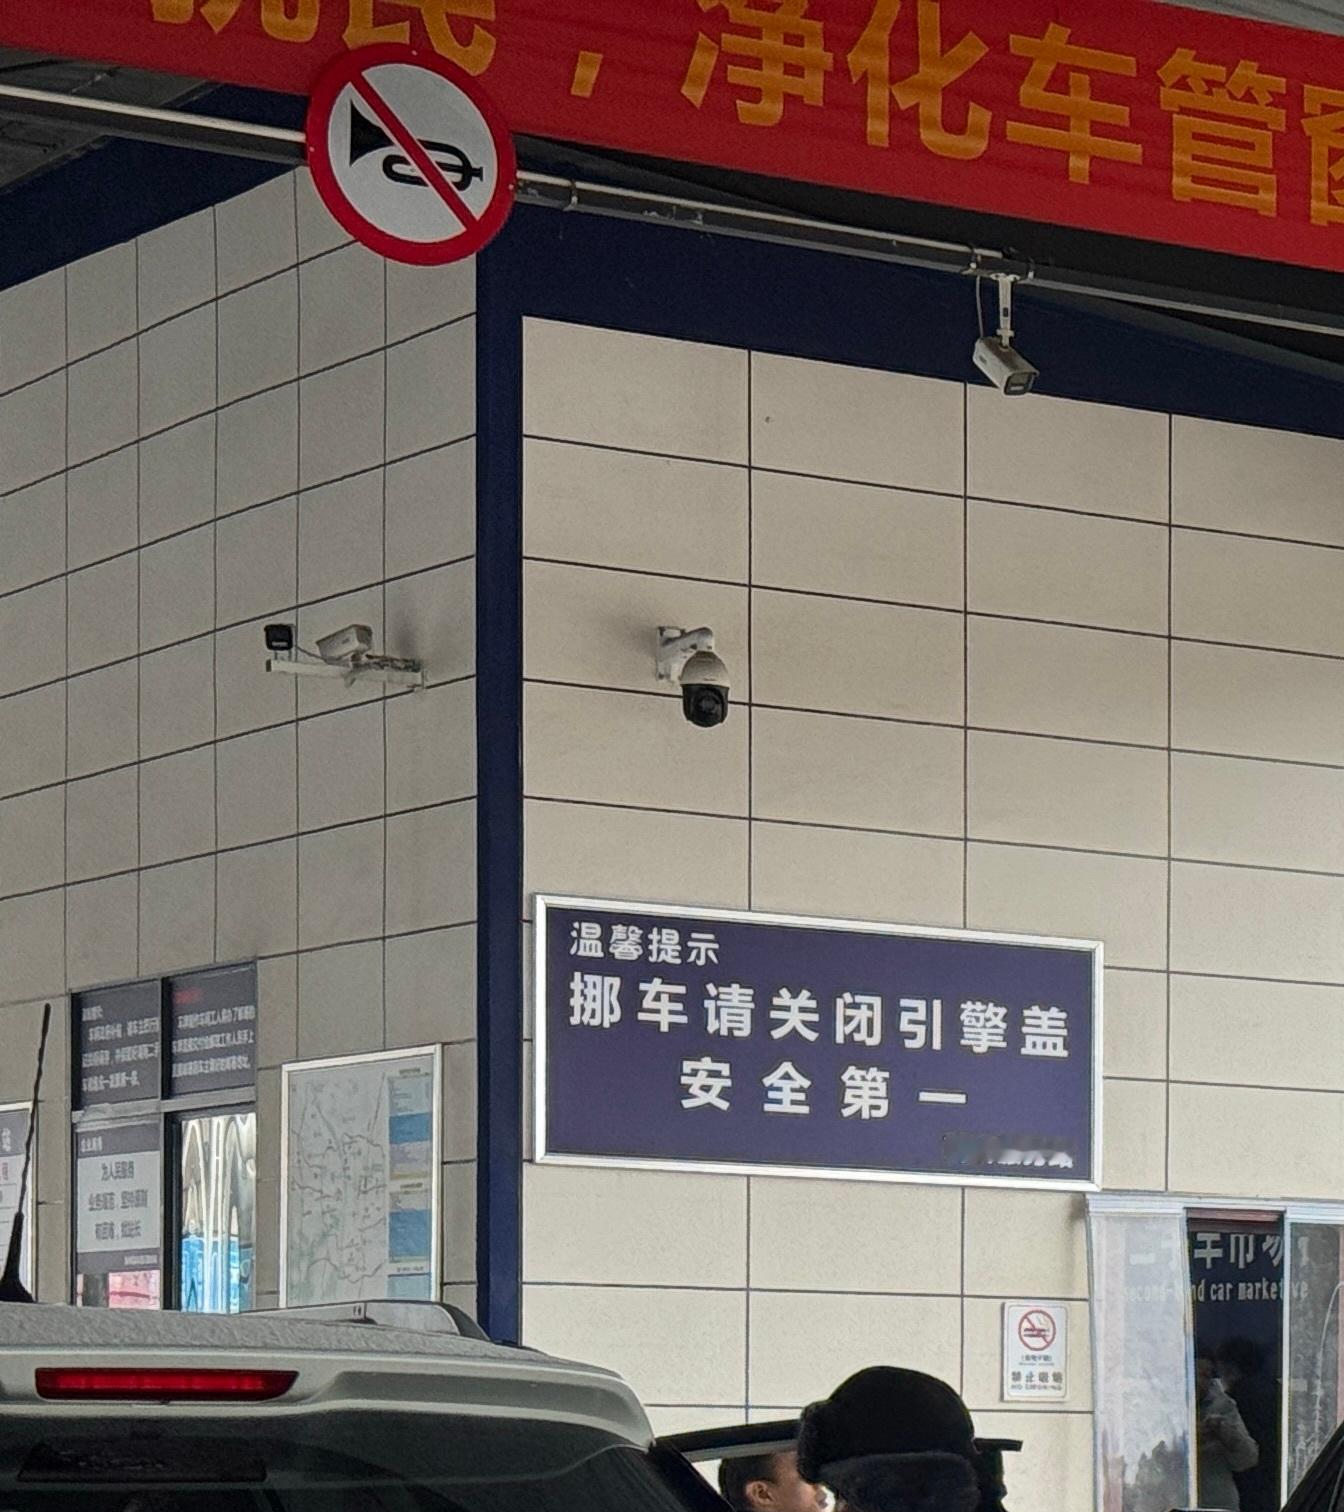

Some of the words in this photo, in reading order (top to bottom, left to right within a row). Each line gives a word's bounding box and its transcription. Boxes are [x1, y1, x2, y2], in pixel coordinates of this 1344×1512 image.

[569, 921, 720, 966] 温馨提示
[569, 971, 1069, 1058] 挪车请关闭引擎盖
[680, 1057, 967, 1120] 安全第一
[1210, 1282, 1233, 1301] car
